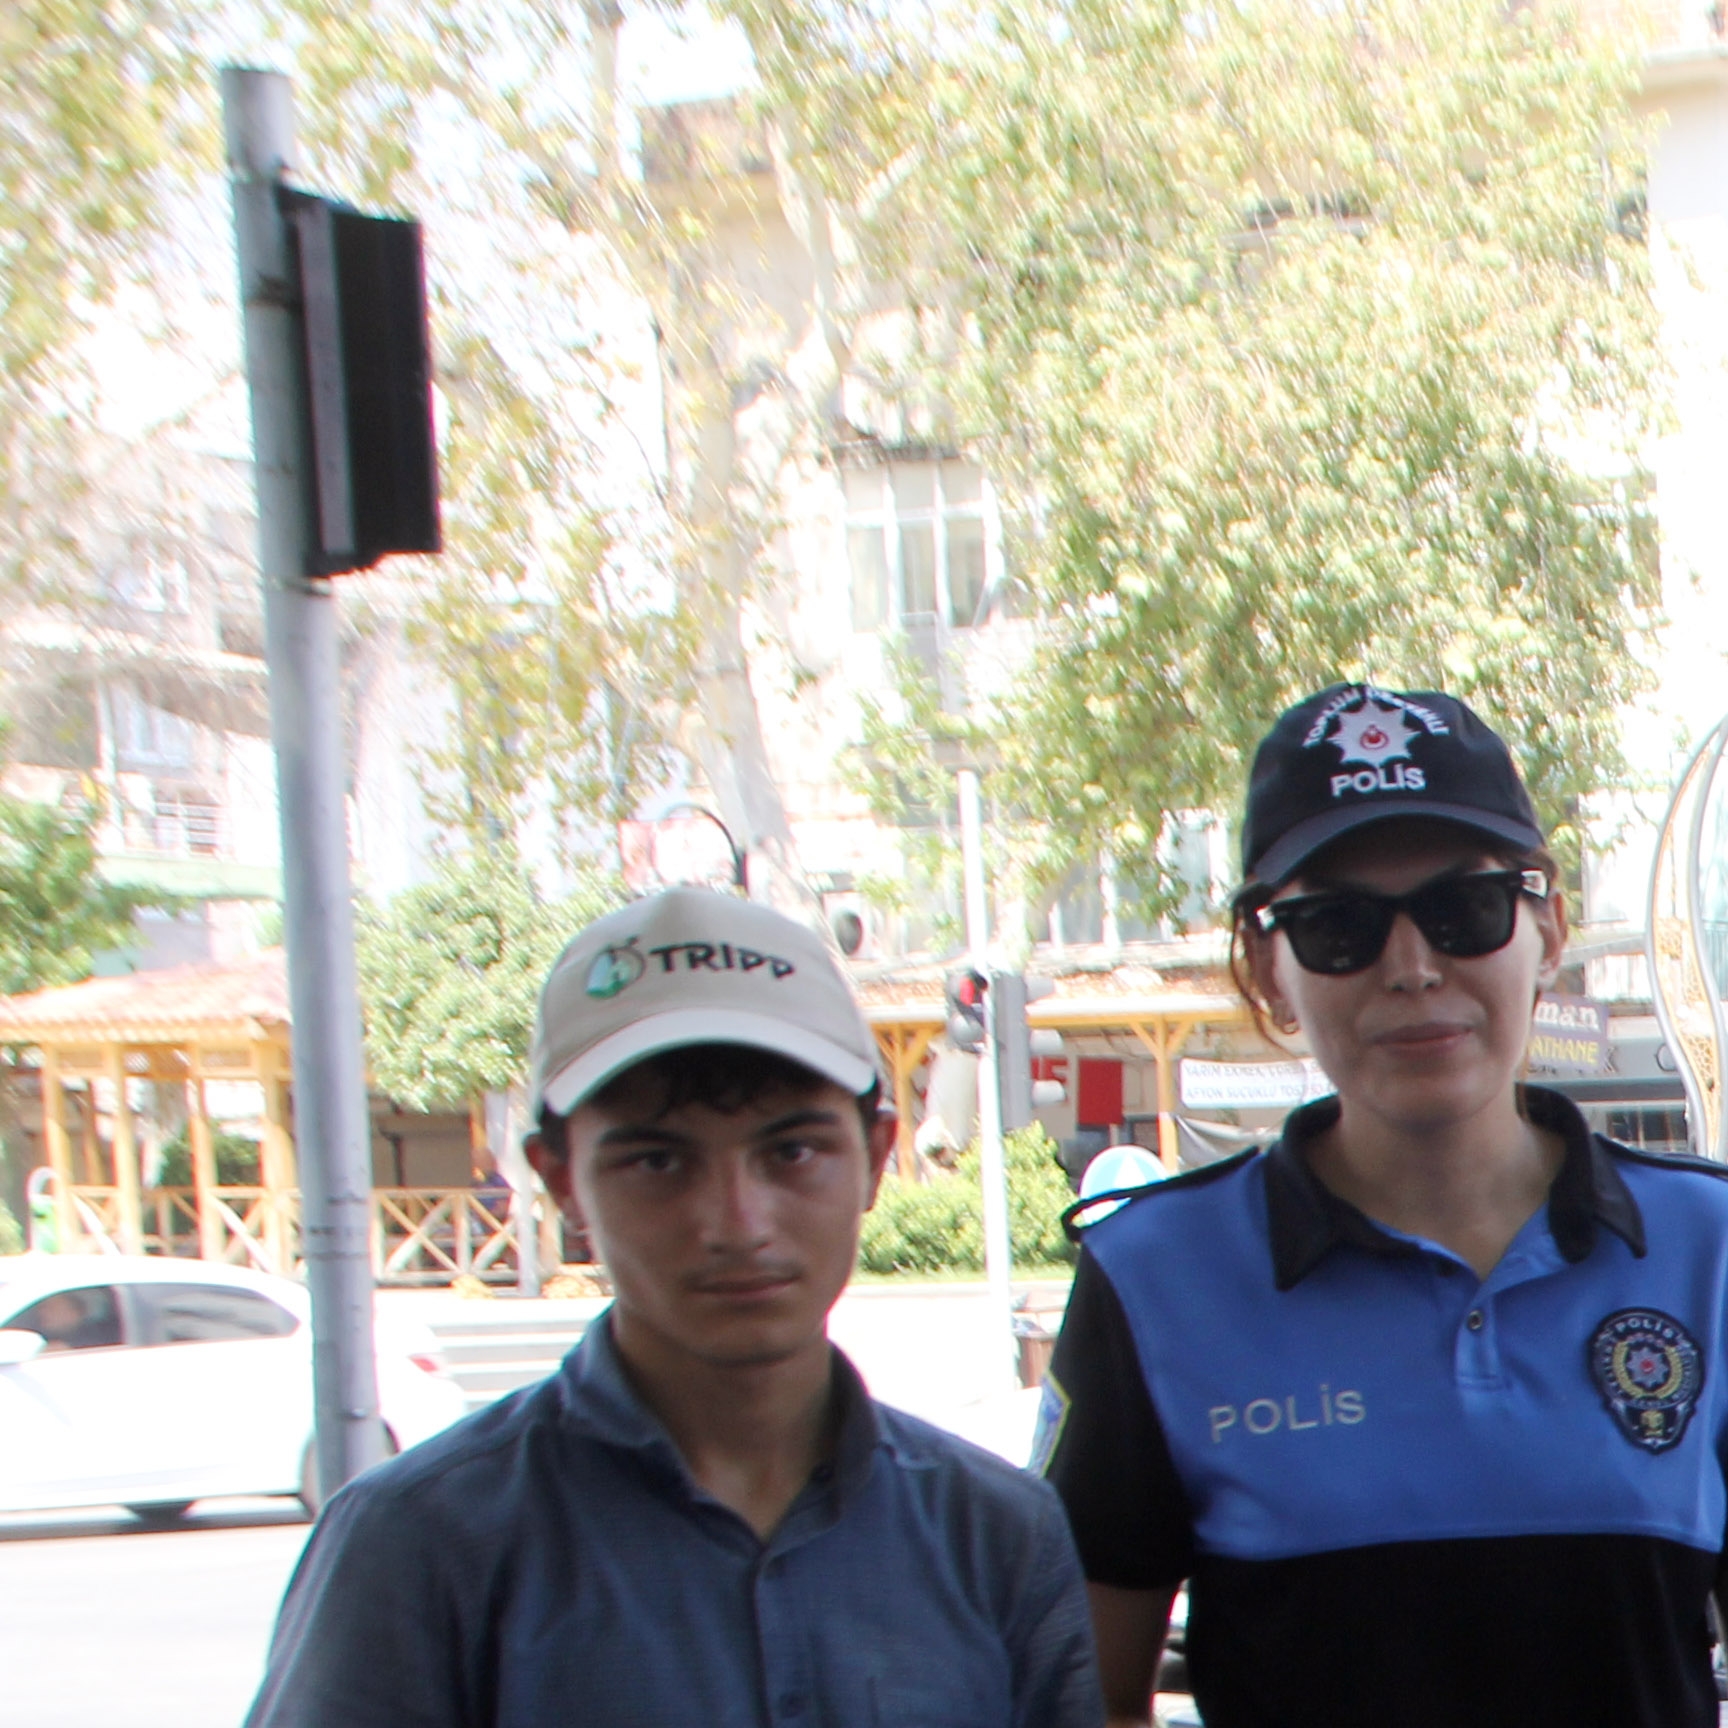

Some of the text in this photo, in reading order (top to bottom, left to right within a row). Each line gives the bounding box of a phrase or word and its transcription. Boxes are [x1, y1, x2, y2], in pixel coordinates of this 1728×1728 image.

[1330, 763, 1427, 797] POLİS
[1534, 1001, 1601, 1031] man
[1528, 1035, 1600, 1066] ATHANE
[1210, 1382, 1367, 1443] POLİS
